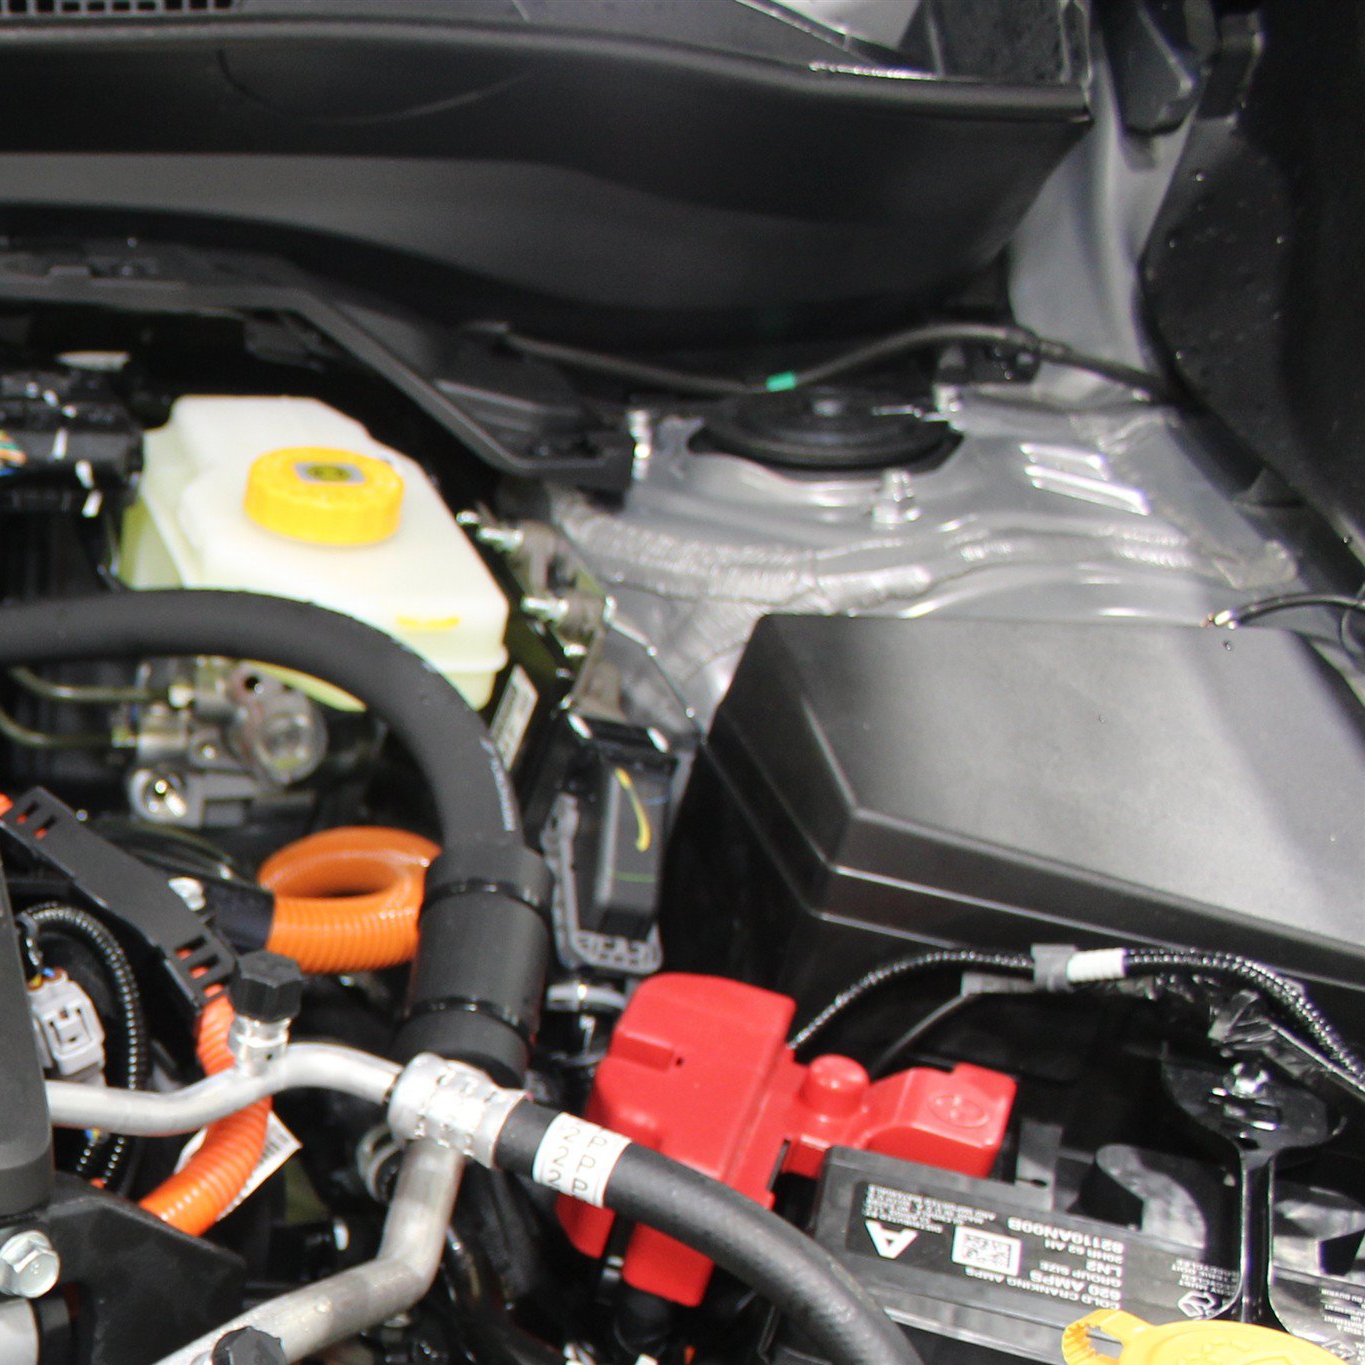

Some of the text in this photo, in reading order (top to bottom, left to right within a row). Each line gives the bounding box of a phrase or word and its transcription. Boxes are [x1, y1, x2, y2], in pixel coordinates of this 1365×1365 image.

[1072, 1268, 1122, 1288] GROUP
[1086, 1260, 1122, 1278] LN2
[964, 1267, 1121, 1311] COLD CRANKING AMPS
[1029, 1270, 1085, 1293] AMPS
